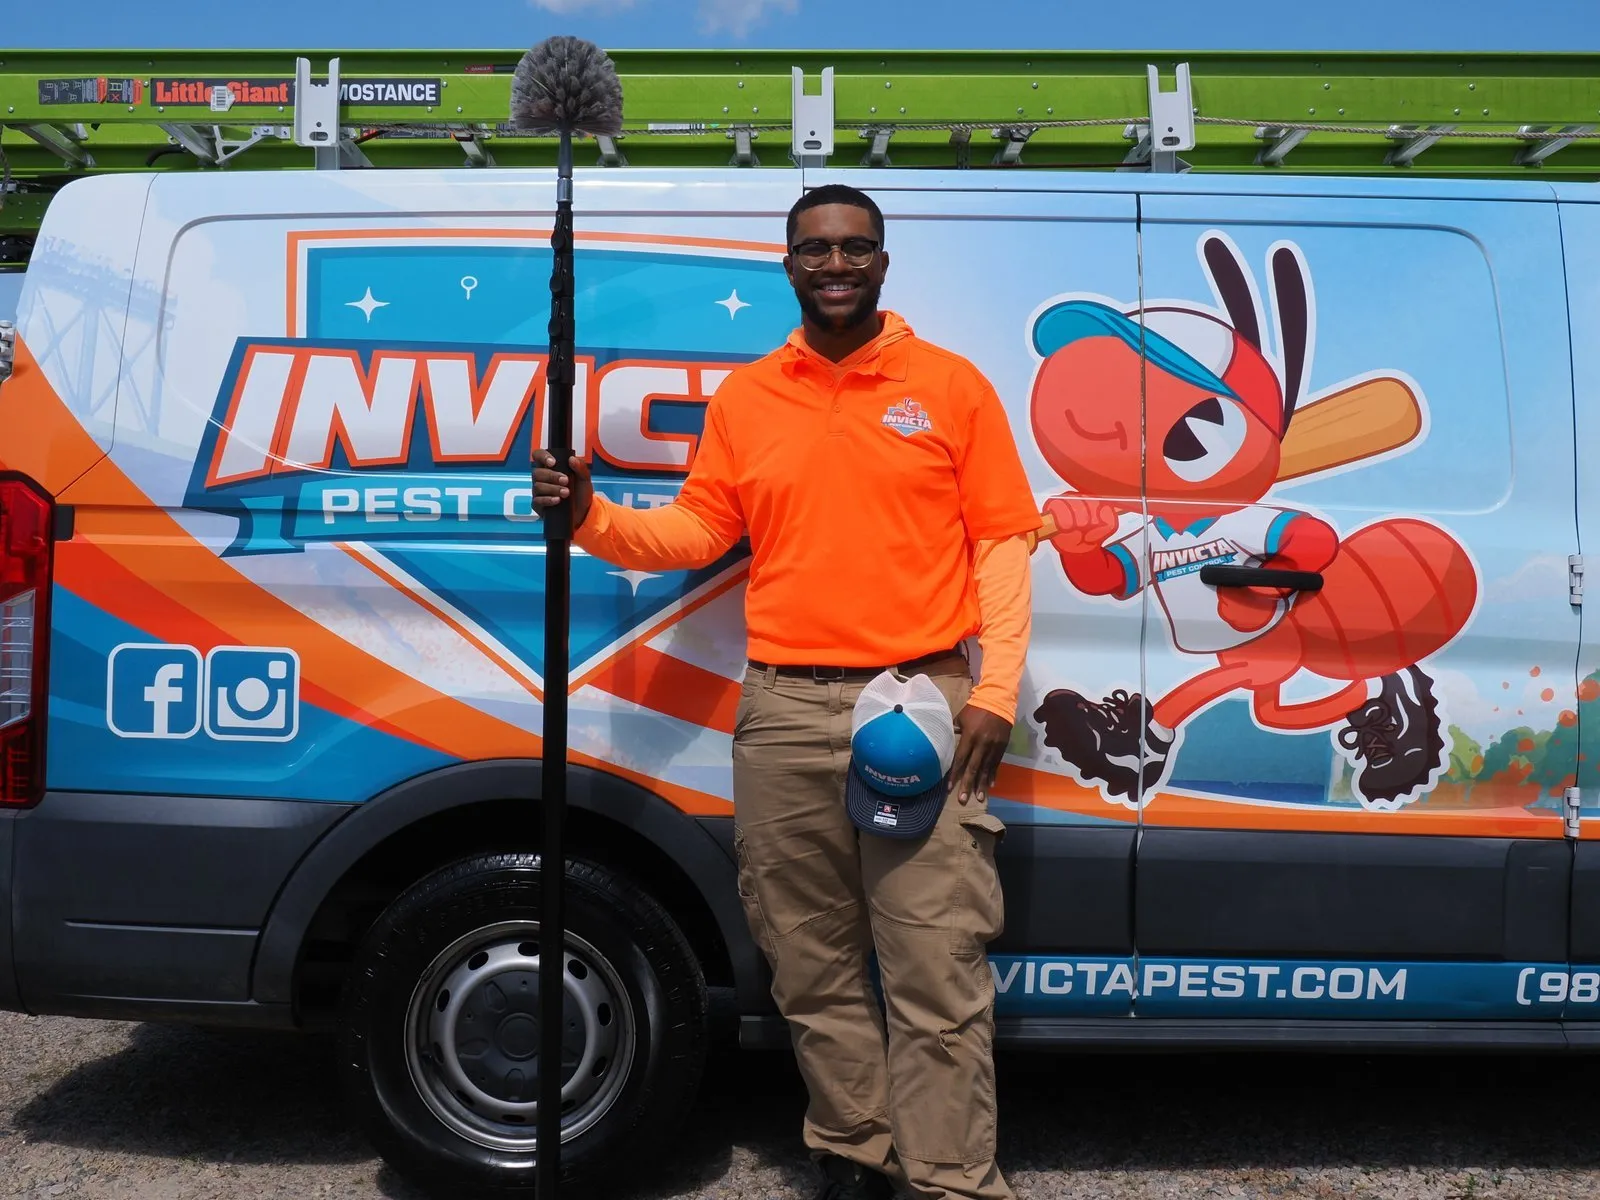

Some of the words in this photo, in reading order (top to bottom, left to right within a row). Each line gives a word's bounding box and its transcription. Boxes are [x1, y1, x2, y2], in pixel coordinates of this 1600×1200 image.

[226, 82, 288, 102] Giant
[206, 345, 740, 487] INVIC
[882, 414, 932, 429] INVICTA
[322, 487, 482, 524] PEST
[1153, 540, 1234, 571] INVICTA
[1166, 567, 1187, 577] PEST
[865, 765, 920, 784] INVICTA
